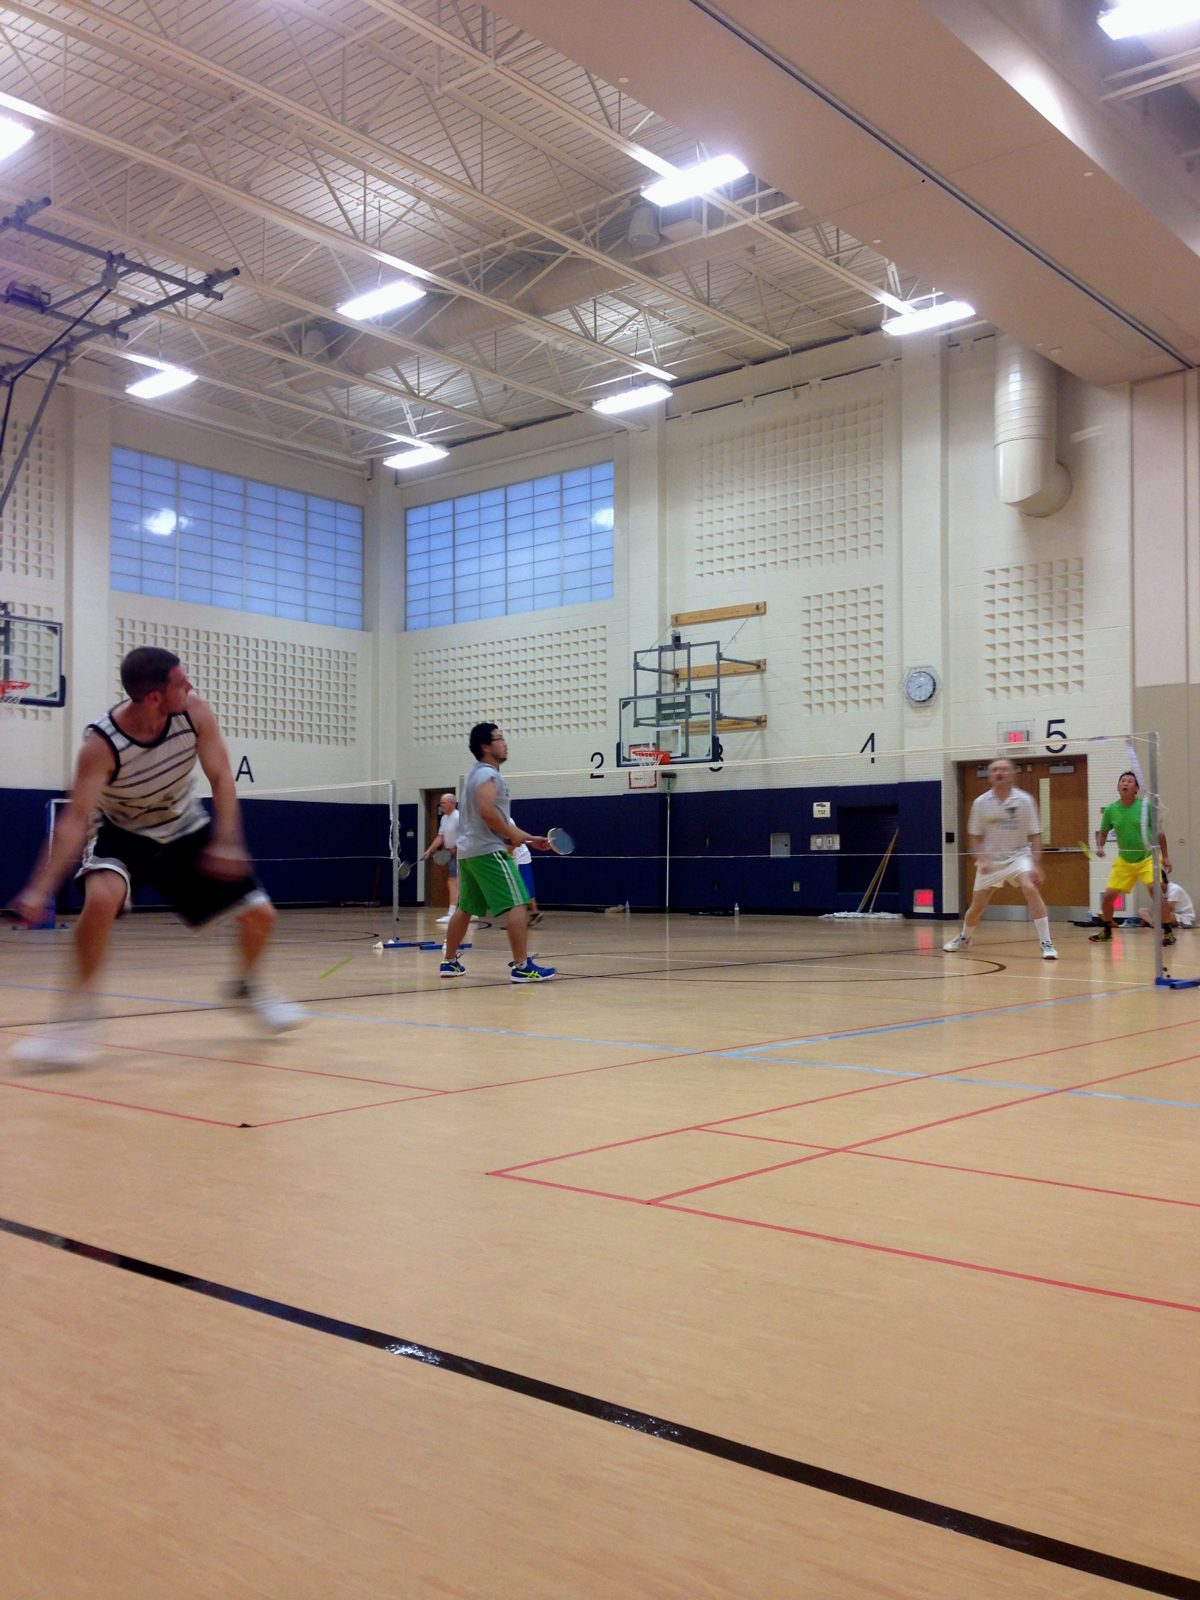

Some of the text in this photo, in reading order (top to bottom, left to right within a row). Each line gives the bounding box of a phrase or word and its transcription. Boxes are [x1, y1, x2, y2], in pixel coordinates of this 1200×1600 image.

[860, 732, 875, 764] 4
[1045, 719, 1067, 753] 5
[235, 755, 254, 783] A
[590, 751, 604, 779] 2
